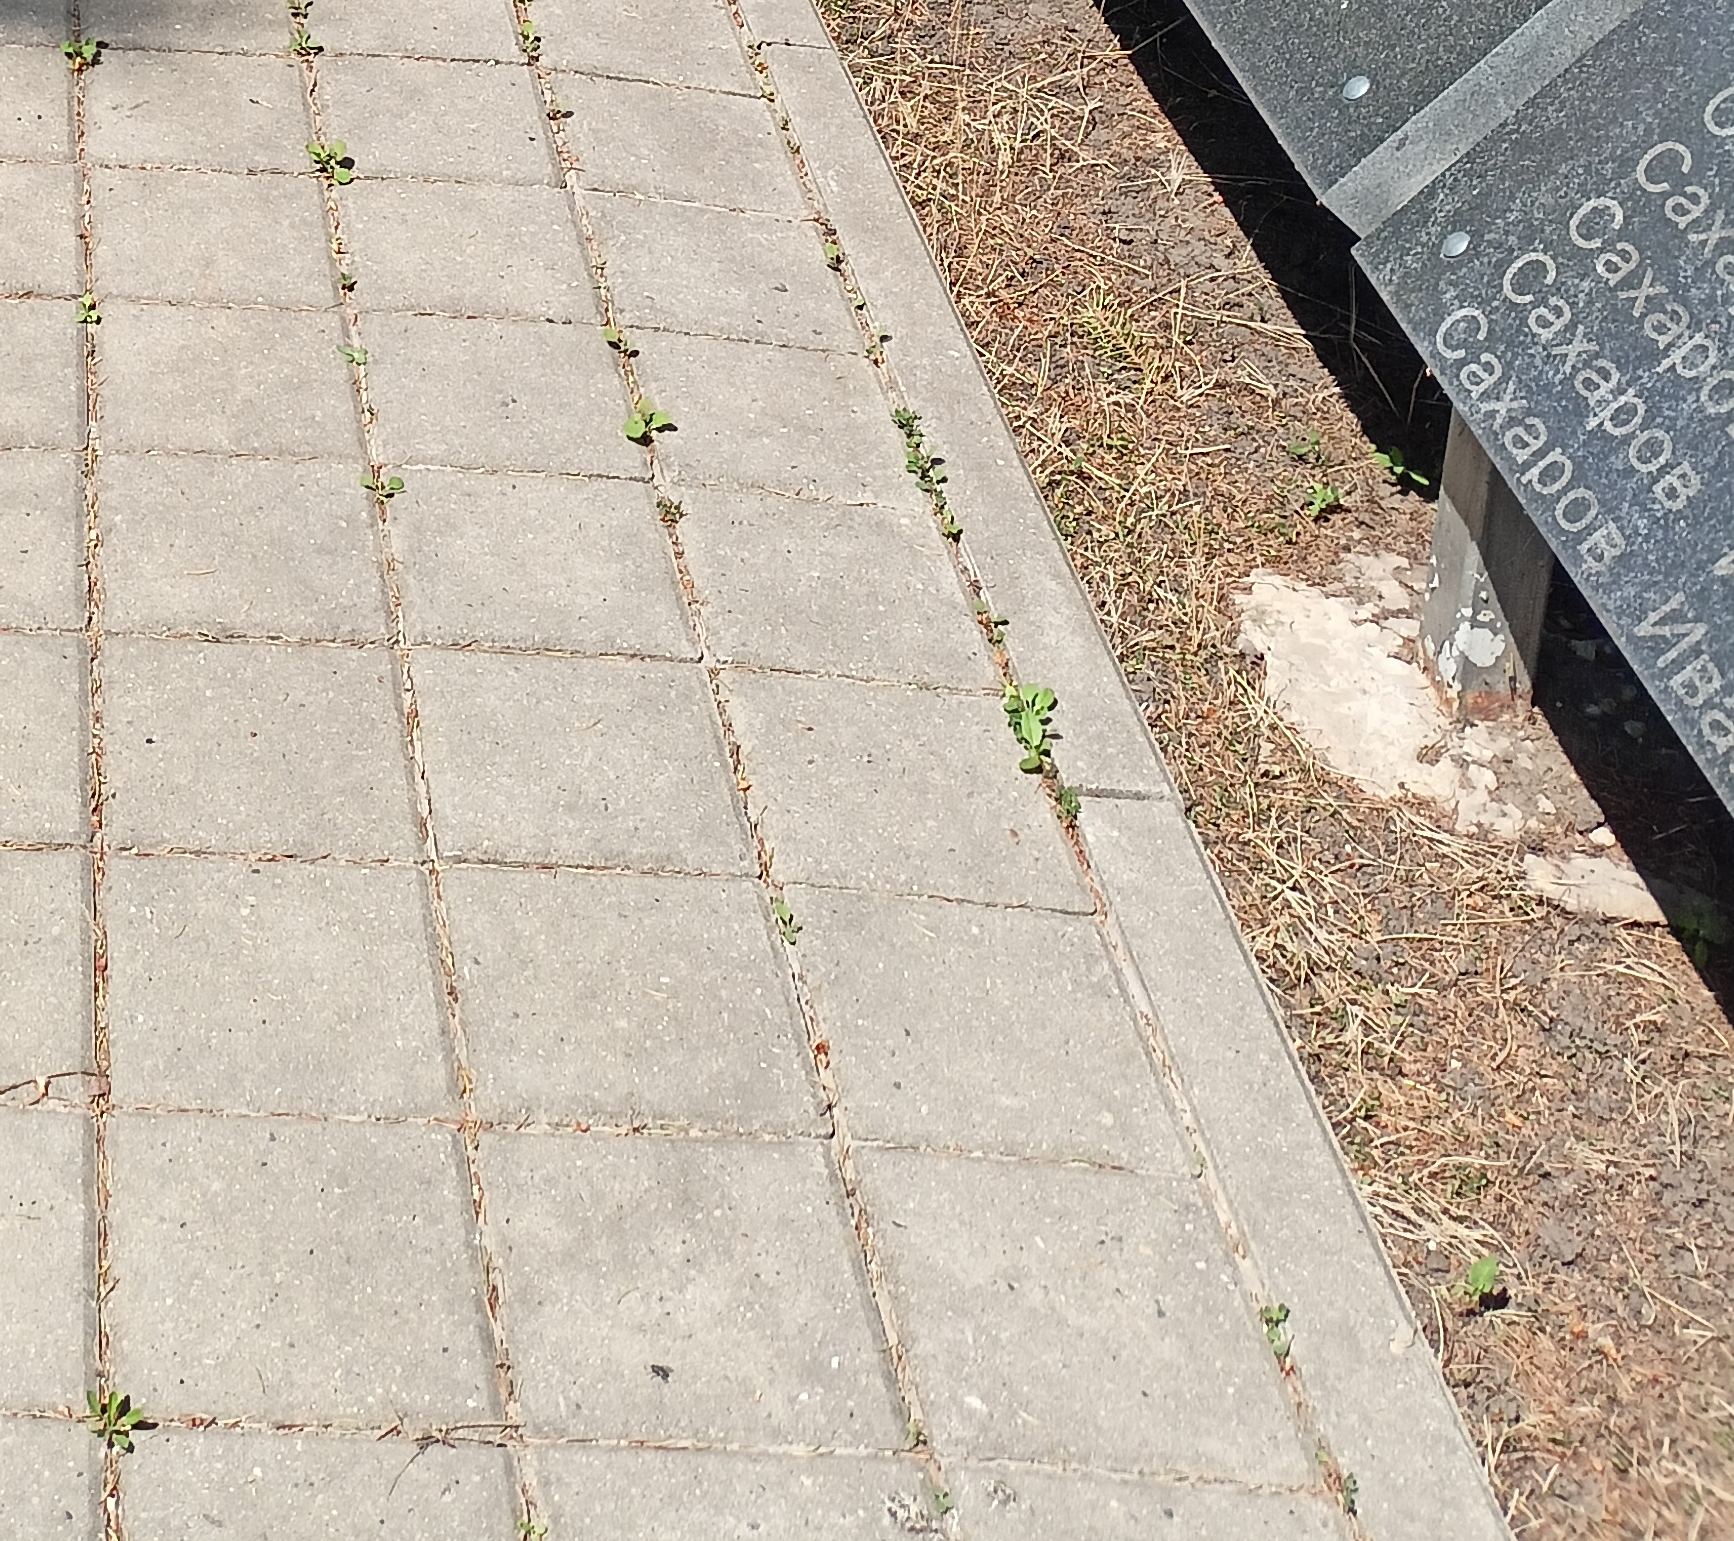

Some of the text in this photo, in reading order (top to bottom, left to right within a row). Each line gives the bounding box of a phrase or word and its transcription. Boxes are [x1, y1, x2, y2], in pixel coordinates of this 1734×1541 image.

[1503, 252, 1701, 511] Сахаров
[1569, 197, 1734, 439] Сахаро
[1437, 307, 1734, 757] Сахаров Ива
